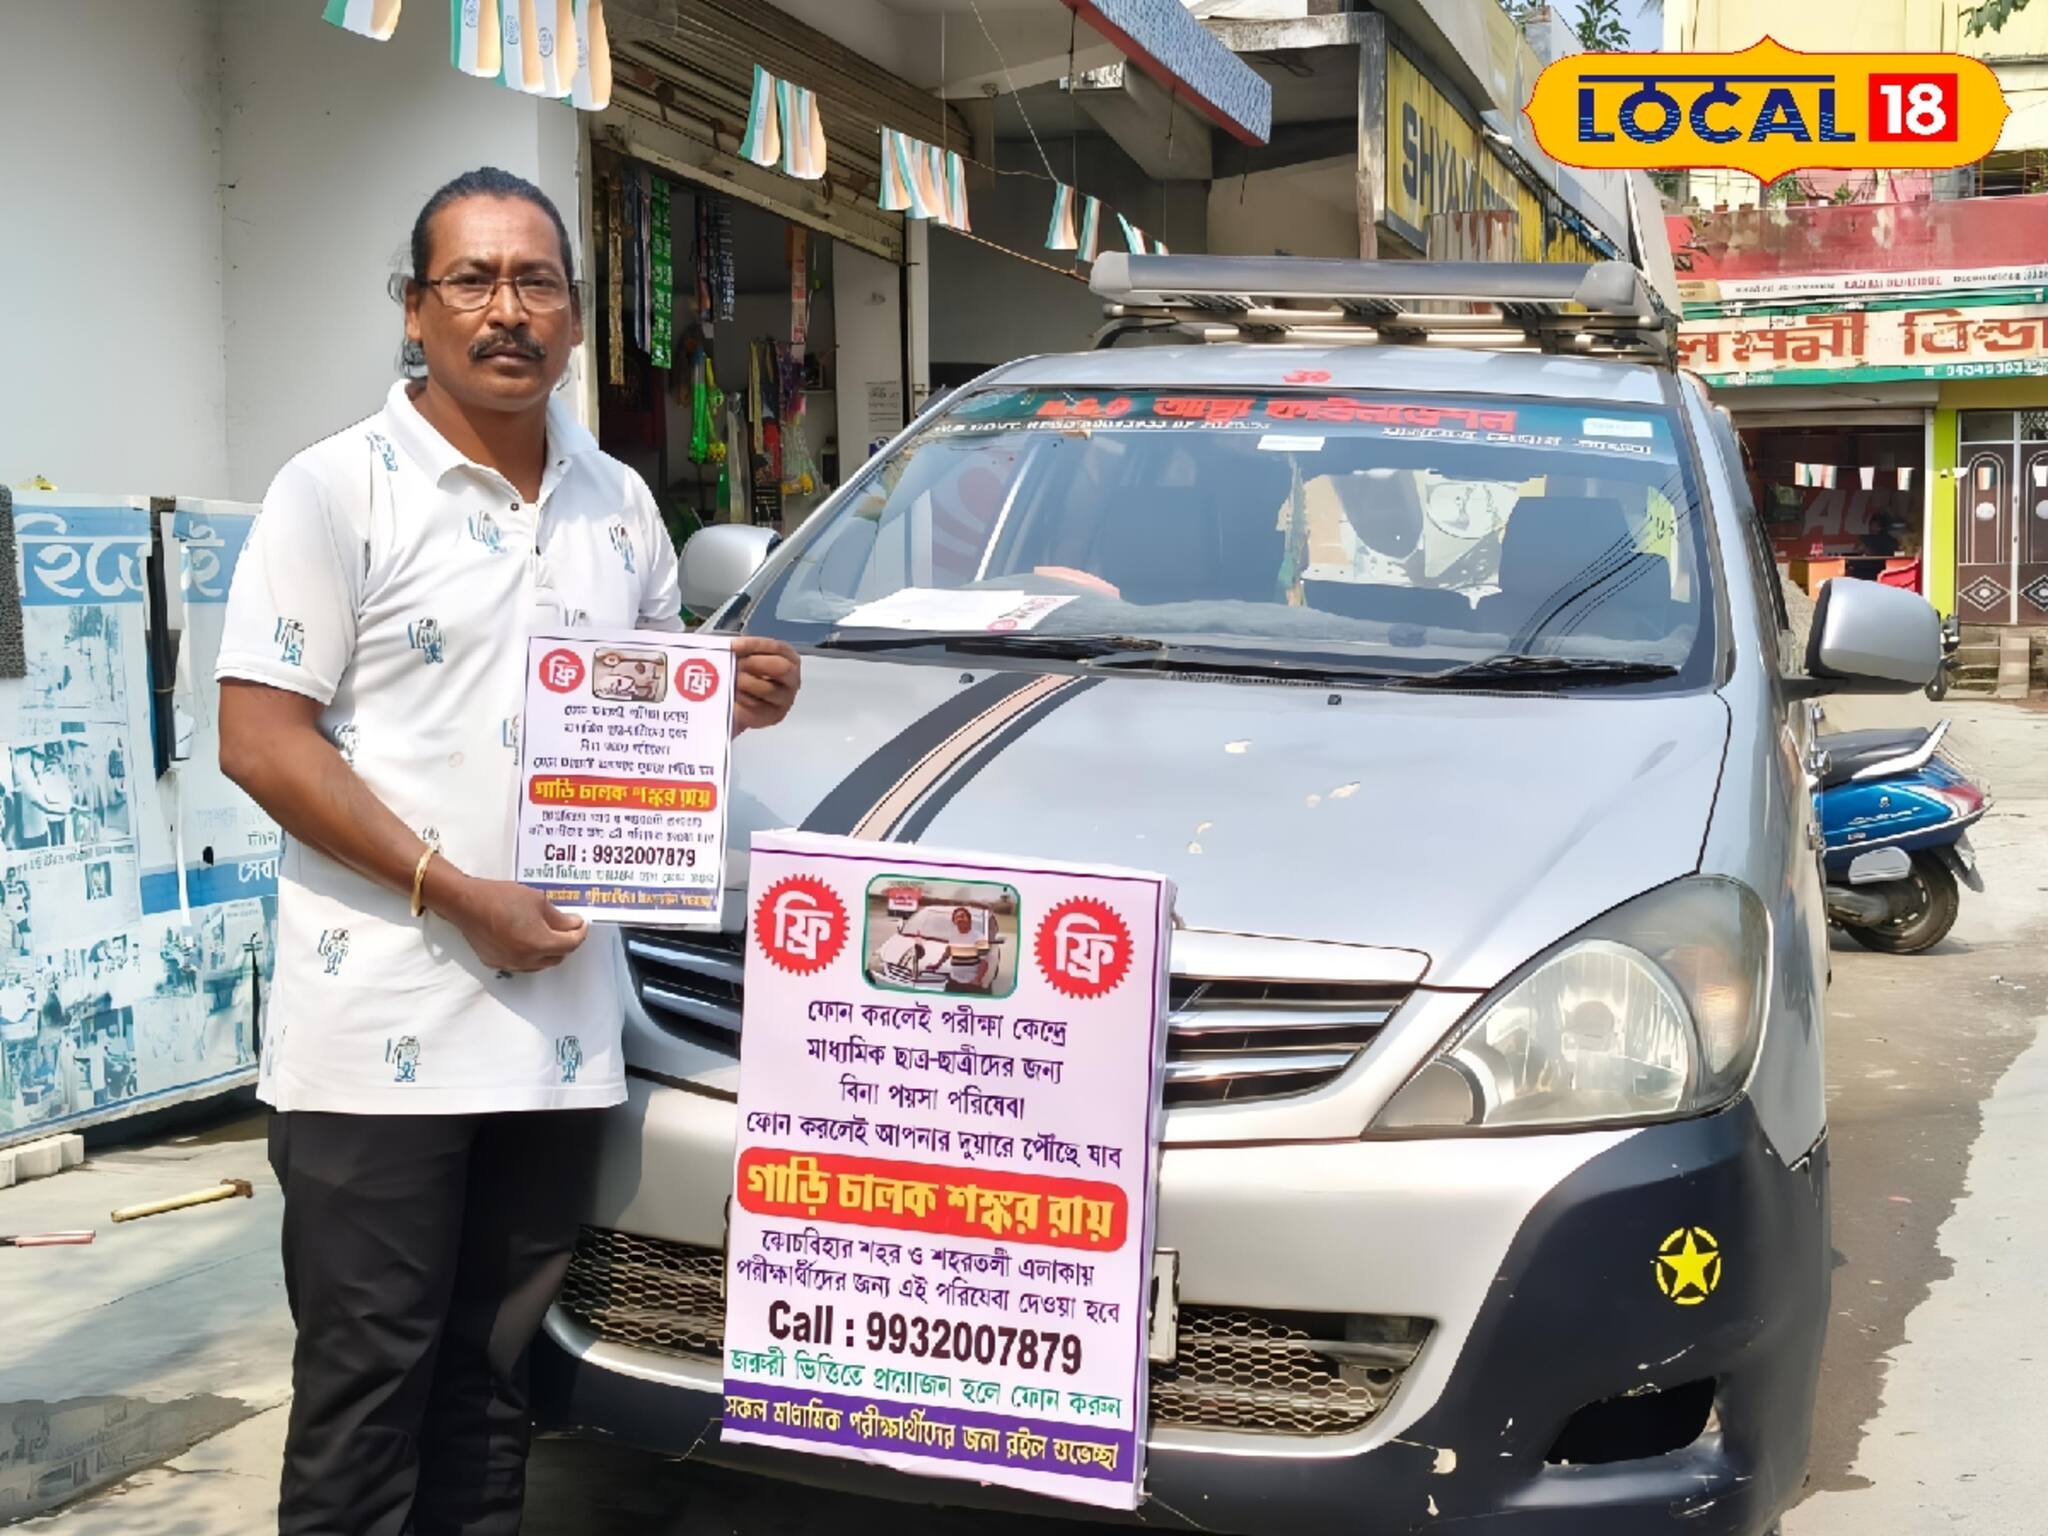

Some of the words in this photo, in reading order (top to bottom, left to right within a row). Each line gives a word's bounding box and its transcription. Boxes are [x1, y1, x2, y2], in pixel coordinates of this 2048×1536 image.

[544, 843, 576, 862] Call
[592, 845, 695, 867] 9932007879
[772, 889, 834, 960] ফ্রি
[1053, 914, 1118, 984] ফ্রি
[808, 1000, 852, 1023] ফোন
[861, 1002, 932, 1033] করলেই
[942, 1005, 1004, 1039] পরীক্ষা
[1013, 1018, 1067, 1046] কেন্দ্রে
[807, 1035, 886, 1065] মাধ্যমিক
[893, 1044, 1014, 1078] ছাত্র-ছাত্রীদের
[1022, 1057, 1063, 1084] জন্য
[839, 1073, 878, 1105] বিনা
[888, 1084, 938, 1110] পয়সা
[948, 1085, 1024, 1120] পরিষেবা
[747, 1111, 791, 1135] ফোন
[798, 1114, 869, 1145] করলেই
[875, 1122, 951, 1152] আপনার
[957, 1130, 1014, 1160] দুয়ারে
[1087, 1143, 1122, 1169] যাব
[747, 1156, 831, 1216] গাড়ি
[836, 1173, 940, 1218] চালক
[945, 1184, 1042, 1235] শঙ্কর
[1047, 1195, 1115, 1242] রায়
[736, 1253, 846, 1292] পরীক্ষার্থীদের
[853, 1272, 891, 1299] জন্য
[899, 1273, 928, 1304] এই
[936, 1276, 1010, 1311] পরিষেবা
[1019, 1293, 1075, 1319] দেওয়া
[1083, 1299, 1120, 1323] হবে
[761, 1226, 853, 1260] কোচবিহার
[858, 1240, 902, 1267] শহর
[908, 1246, 923, 1265] ও
[930, 1247, 1012, 1277] শহরতলী
[1018, 1259, 1095, 1288] এলাকায়
[768, 1300, 834, 1345] Call
[866, 1311, 1082, 1375] 9932007879
[794, 1350, 866, 1386] ভিত্তিতে
[873, 1367, 951, 1398] প্রয়োজন
[960, 1378, 1000, 1405] হলে
[1011, 1385, 1060, 1412] ফোন
[1066, 1392, 1123, 1418] করুন
[724, 1395, 768, 1422] সকল
[773, 1398, 843, 1431] মাধ্যমিক
[849, 1404, 956, 1449] পরীক্ষার্থীদের
[962, 1425, 1000, 1453] জন্য
[1006, 1426, 1048, 1459] রইল
[1053, 1438, 1120, 1471] শুভেচ্ছা
